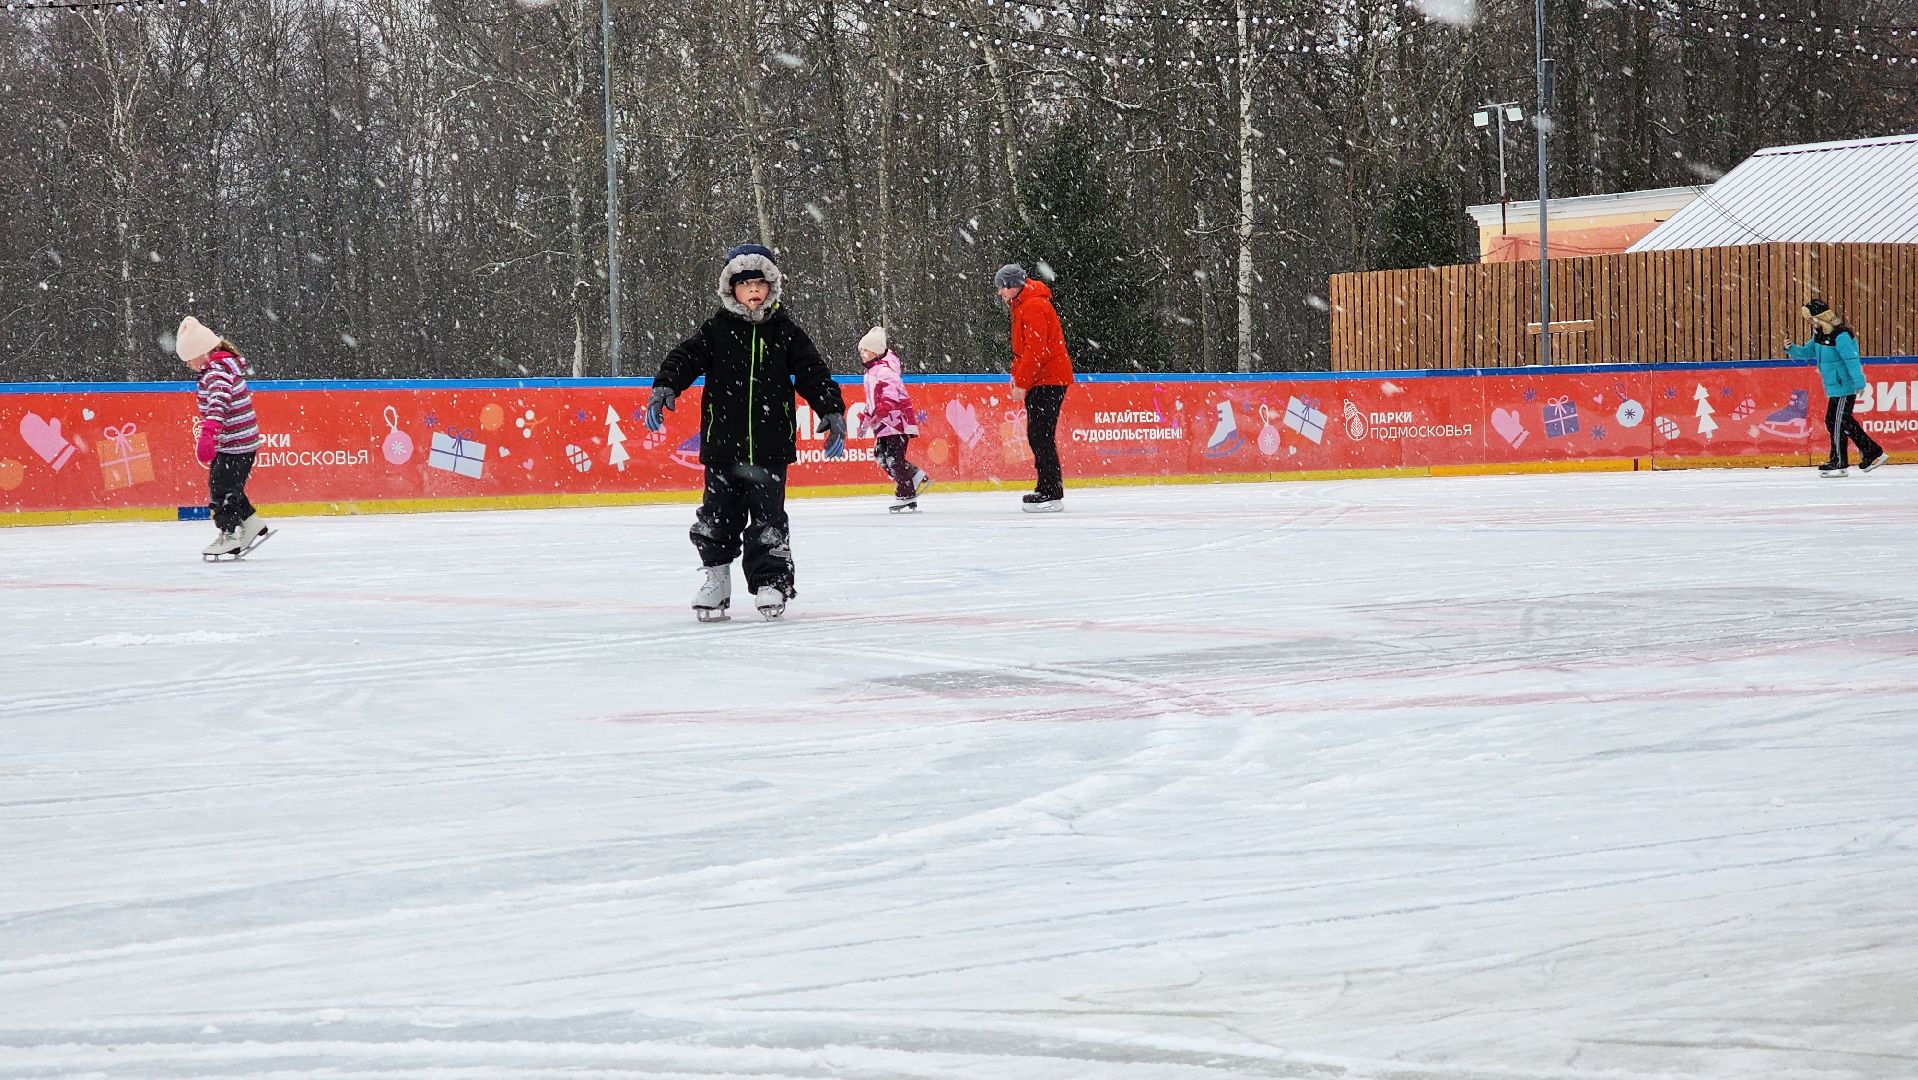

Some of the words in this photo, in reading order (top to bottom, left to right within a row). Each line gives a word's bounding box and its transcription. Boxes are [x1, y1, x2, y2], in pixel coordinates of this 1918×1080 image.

[1094, 409, 1160, 423] КАТАЙТЕСЬ
[1370, 411, 1412, 425] ПАРКИ
[1370, 424, 1472, 439] ПОДМОСКОВЬЯ
[258, 433, 291, 448] РКИ
[252, 449, 369, 468] ДМОСКОВЬЯ
